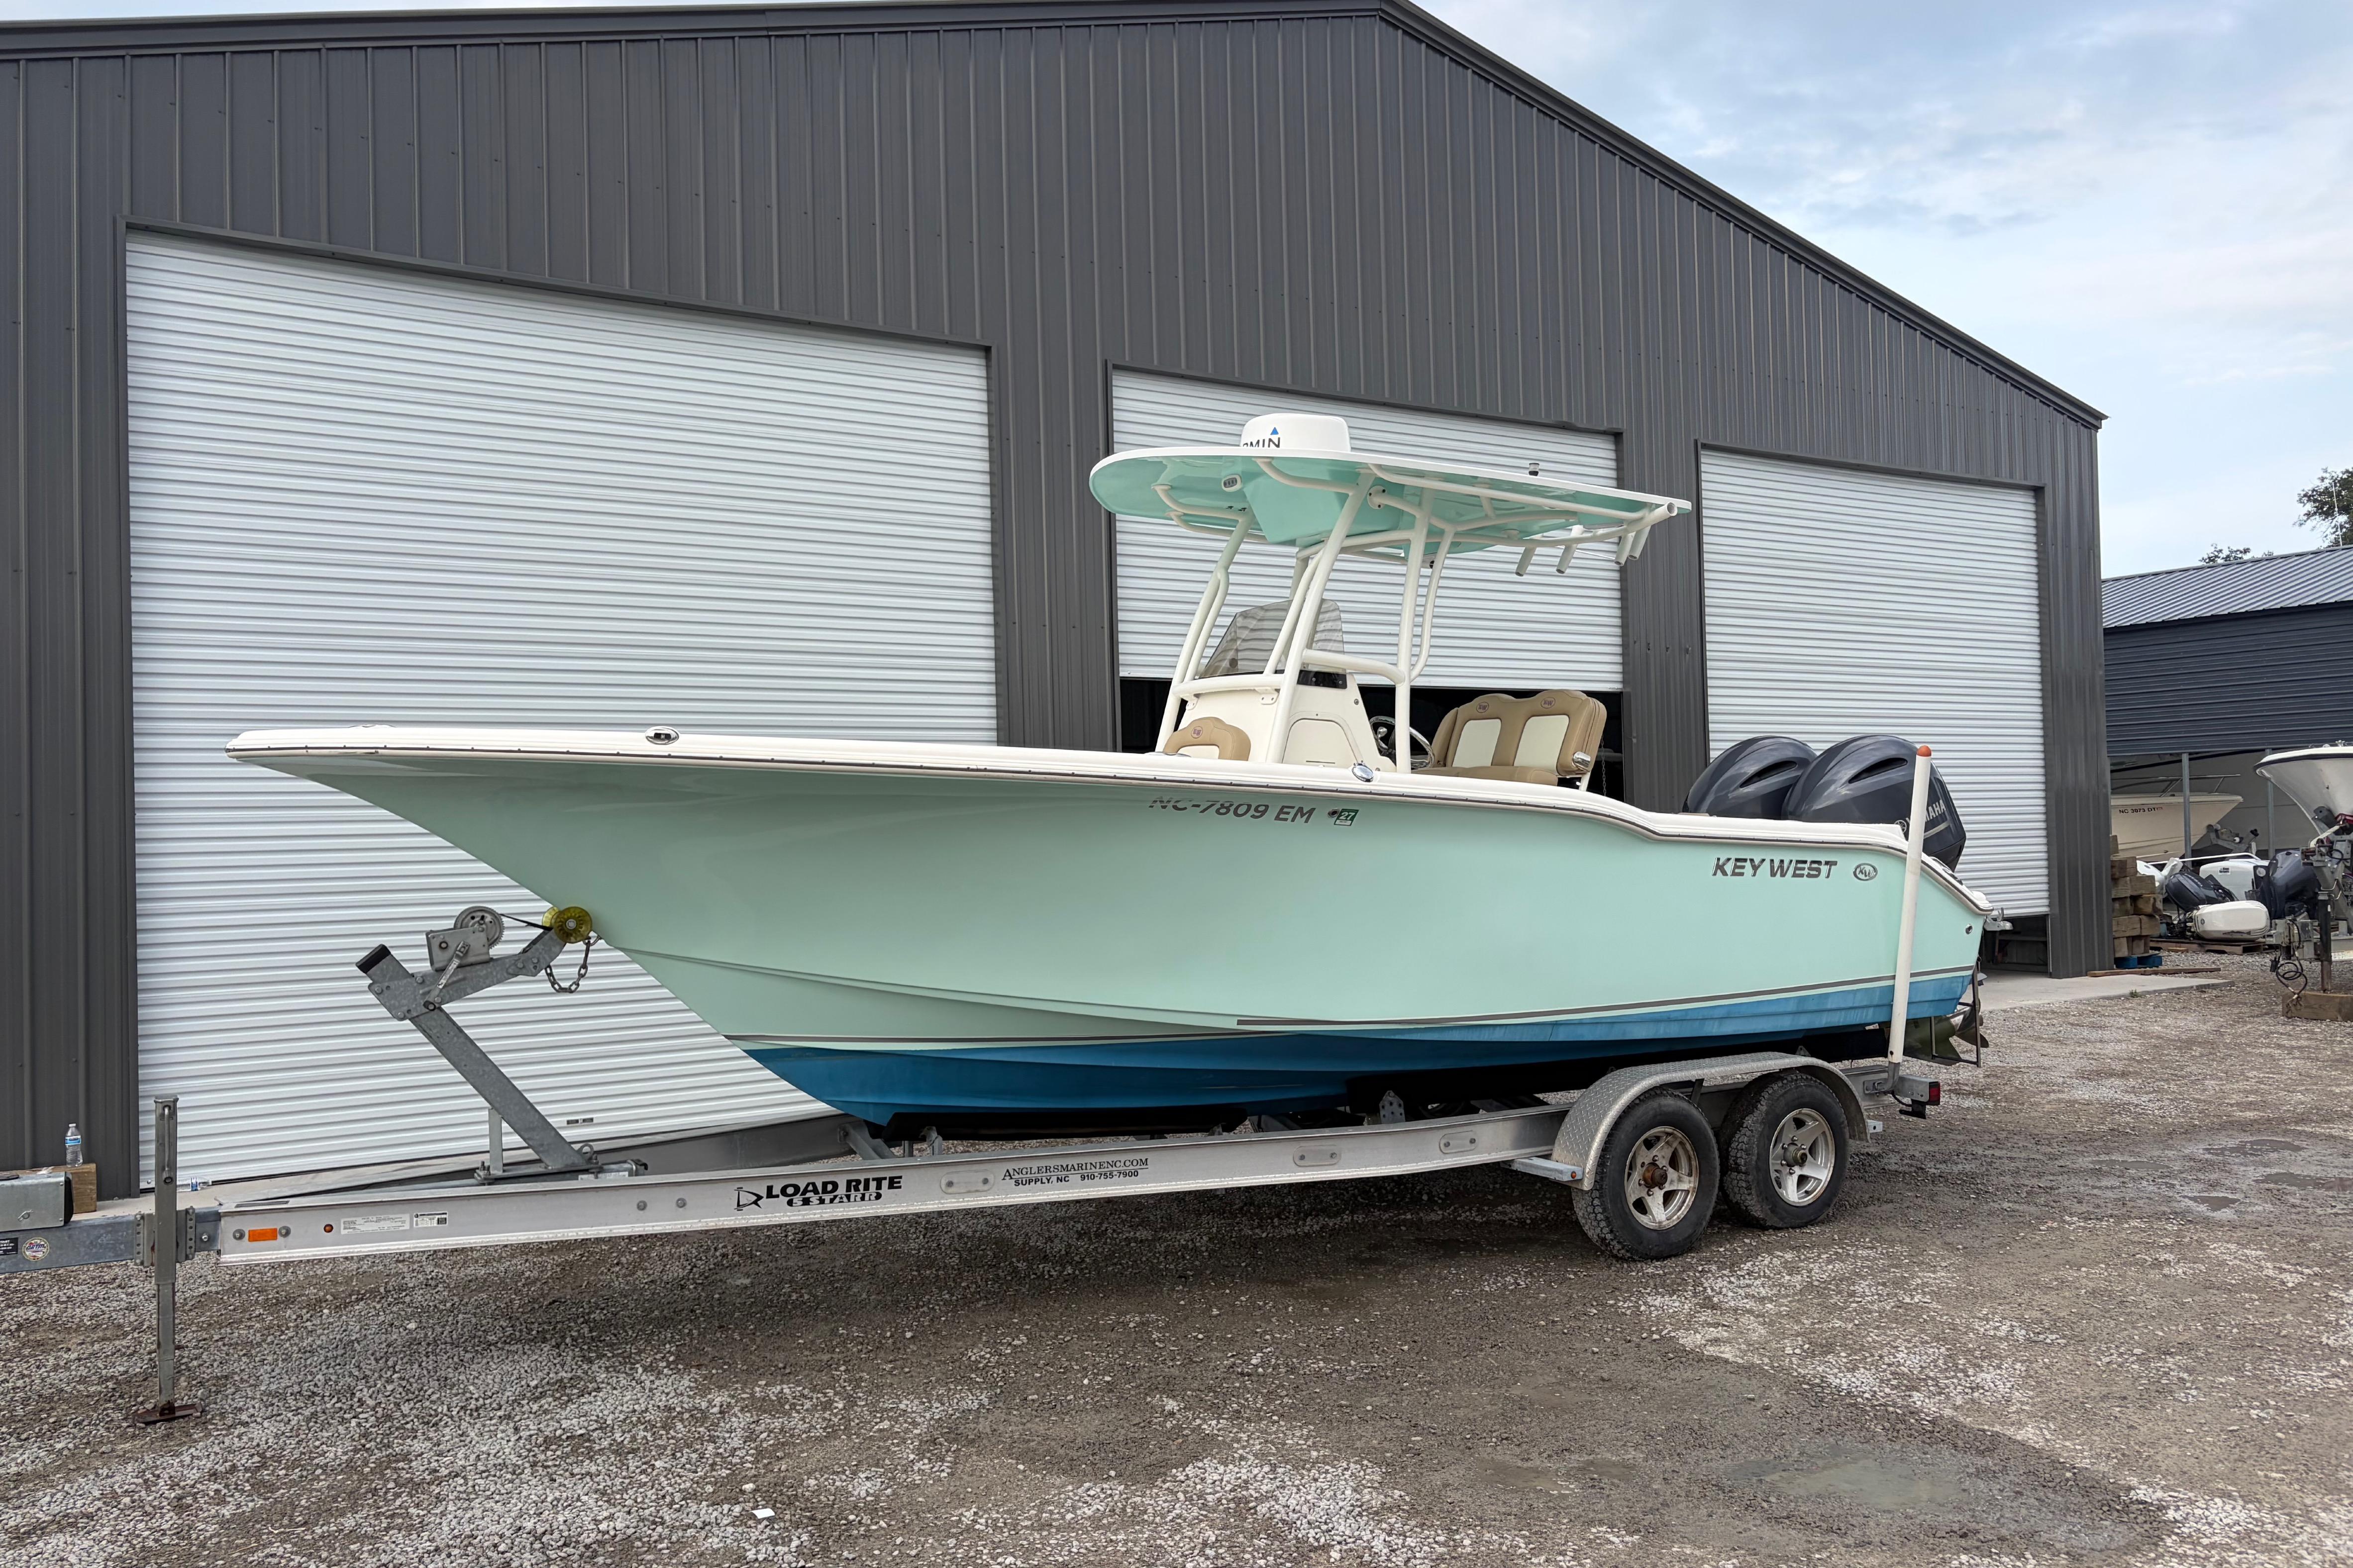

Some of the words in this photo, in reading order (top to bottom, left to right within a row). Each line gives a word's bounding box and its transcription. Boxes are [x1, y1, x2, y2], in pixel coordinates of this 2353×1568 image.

[1273, 805, 1317, 824] EM
[1338, 811, 1356, 820] 27
[1711, 857, 1766, 877] KEY
[1769, 859, 1838, 879] WEST
[1001, 1158, 1149, 1180] ANGLERSMARINENC.COM
[1014, 1176, 1054, 1187] SUPPLY,
[1056, 1175, 1070, 1183] NC
[1080, 1170, 1139, 1181] 910-755-7900
[765, 1180, 839, 1199] LOAD
[845, 1175, 903, 1193] RITE
[792, 1197, 805, 1207] 5
[809, 1191, 878, 1206] STARR
